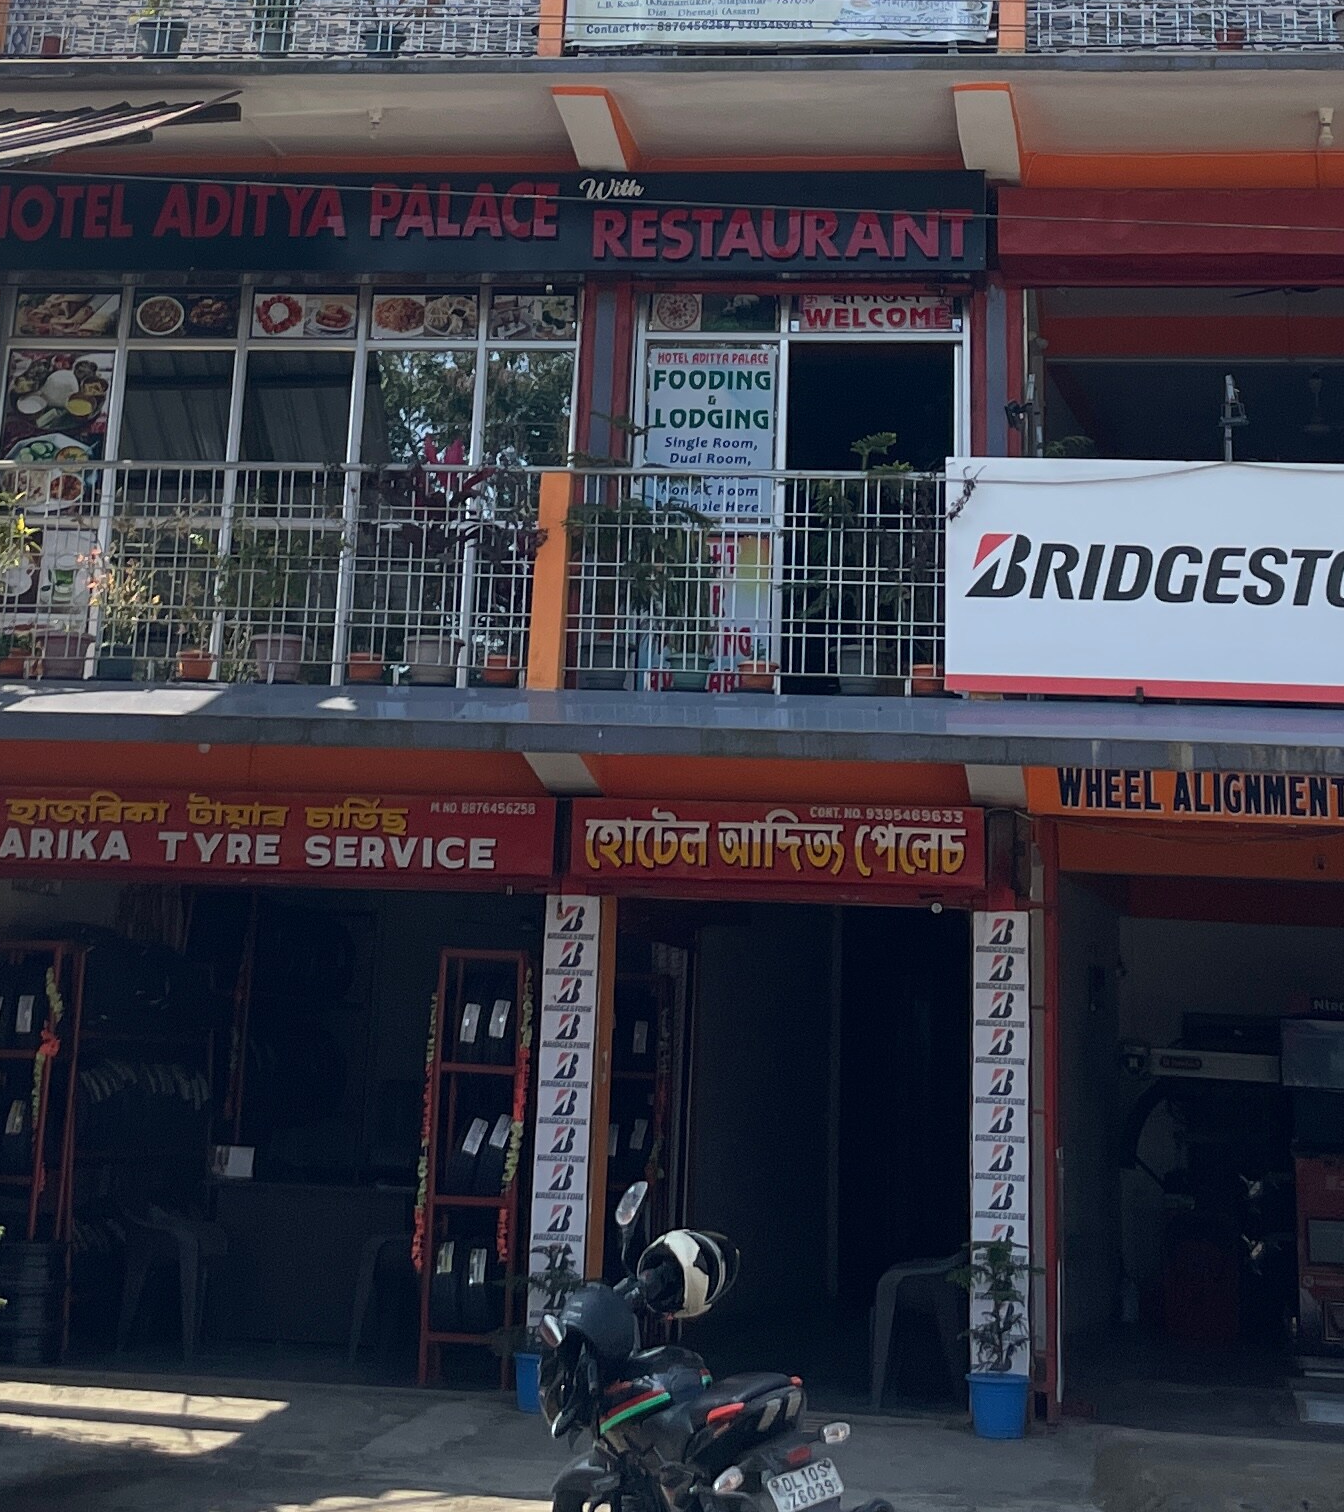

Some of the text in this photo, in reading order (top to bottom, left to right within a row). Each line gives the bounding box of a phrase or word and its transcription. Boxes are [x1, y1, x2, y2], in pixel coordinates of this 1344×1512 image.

[722, 6, 760, 17] (Assam)
[586, 23, 629, 34] Contact
[579, 178, 644, 200] With
[153, 184, 347, 238] ADITYA
[369, 182, 560, 241] PALACE
[592, 208, 973, 261] RESTAURANT
[804, 308, 951, 327] WELCOME
[658, 352, 768, 365] HOTEL ADITYA PALACE
[654, 369, 771, 390] FOODING
[708, 395, 716, 405] &
[654, 409, 769, 430] LODGING
[664, 437, 758, 451] Single Room,
[669, 453, 752, 466] Dual Room,
[1057, 768, 1163, 812] WHEEL
[866, 808, 964, 823] 9395469633
[158, 831, 281, 866] TYRE
[304, 835, 497, 871] SERVICE
[585, 807, 709, 870] হোটেল
[718, 808, 846, 875] আদিত্য
